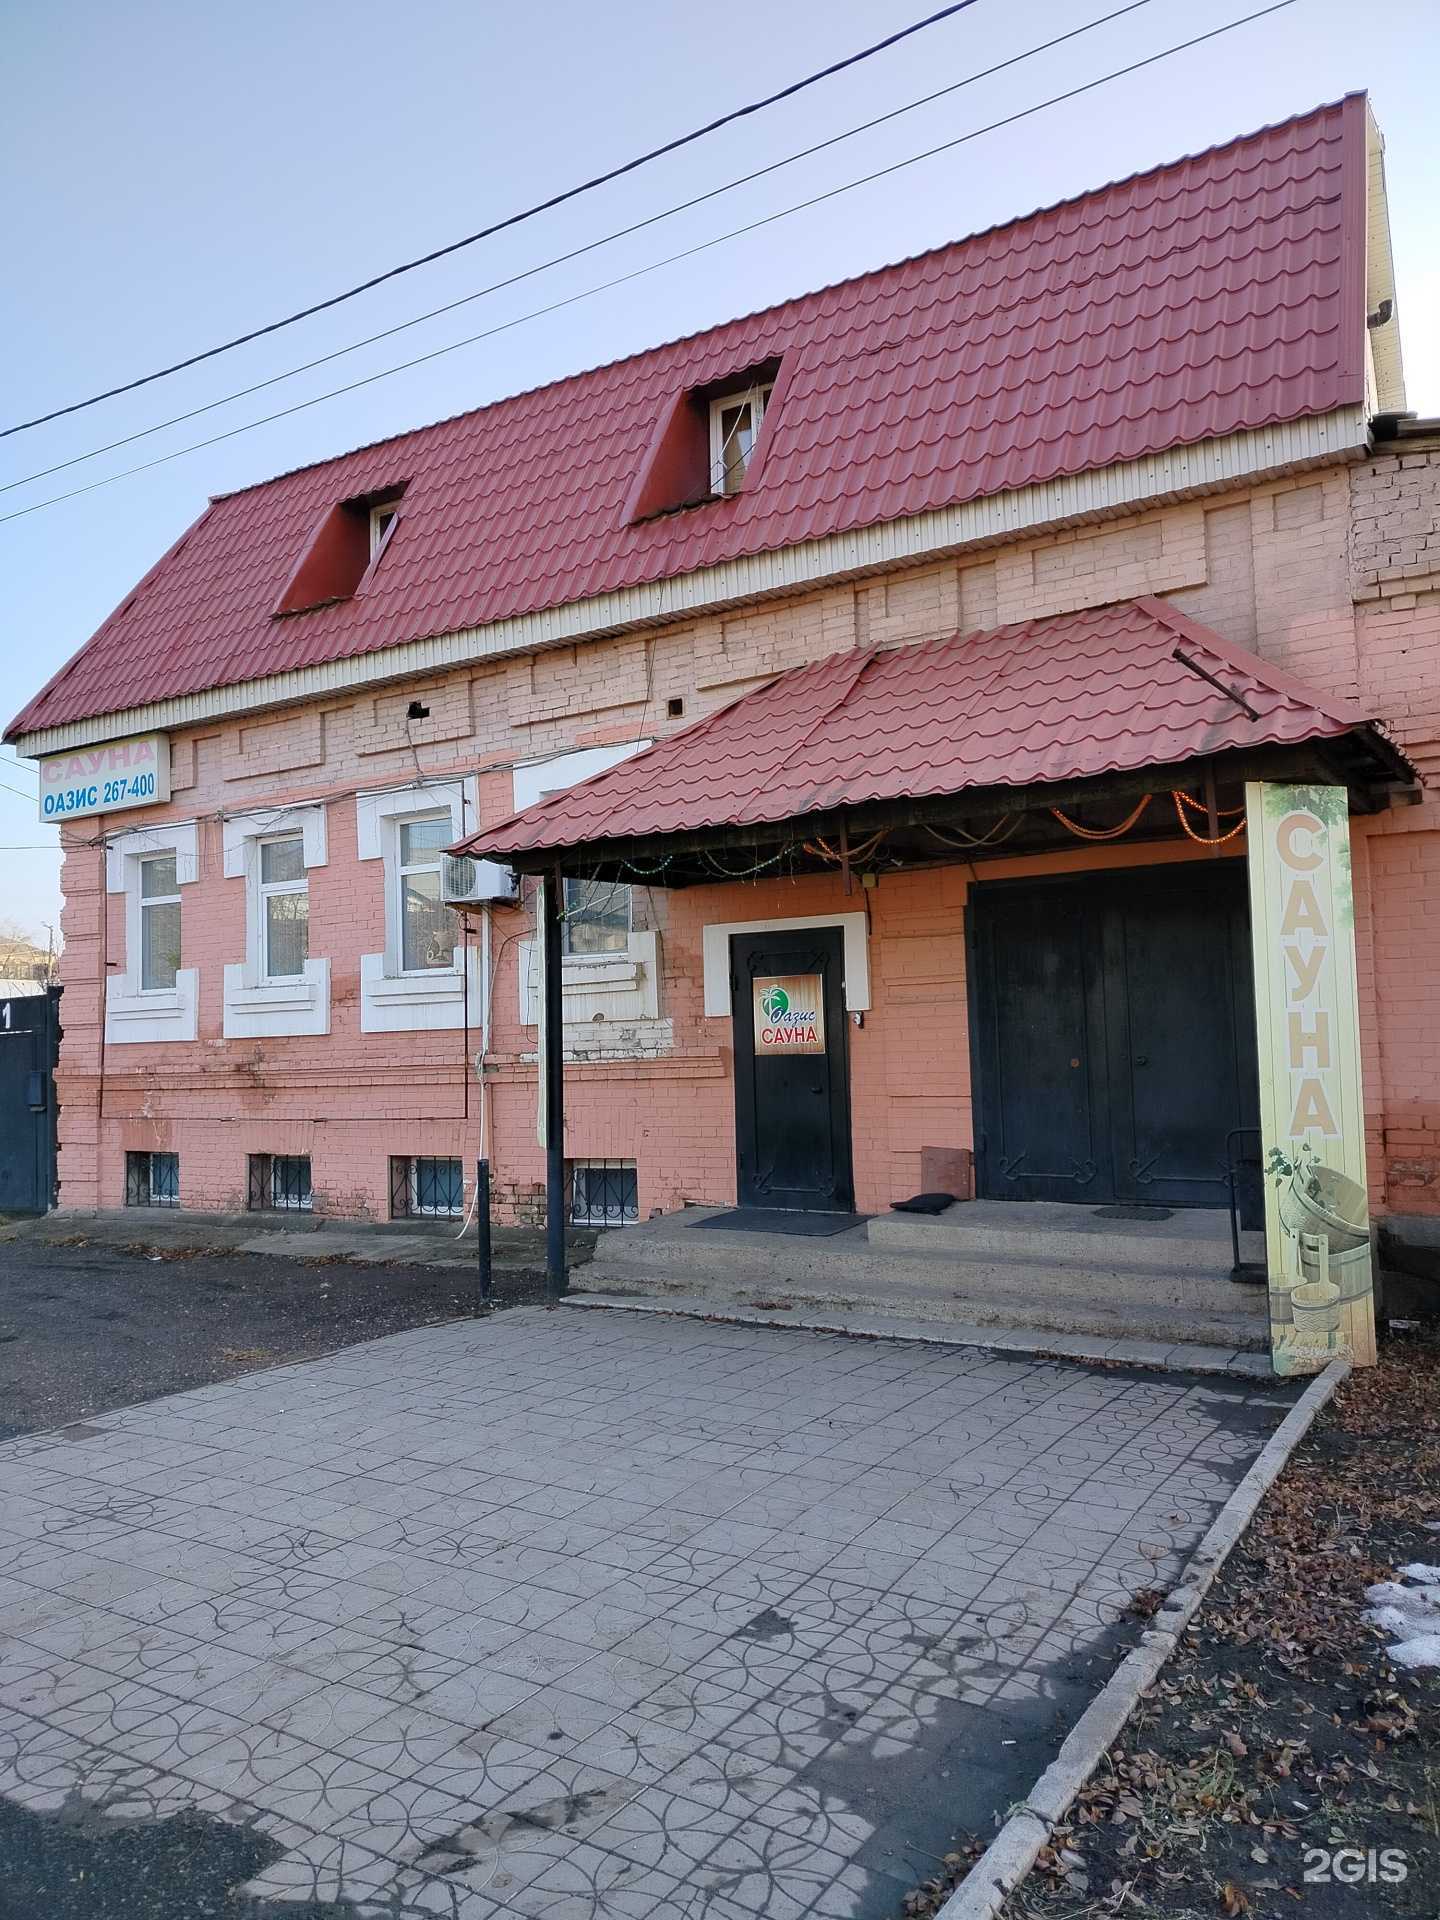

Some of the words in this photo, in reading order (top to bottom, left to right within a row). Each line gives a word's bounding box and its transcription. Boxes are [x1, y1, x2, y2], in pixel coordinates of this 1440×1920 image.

[42, 740, 154, 784] САУНА
[44, 786, 98, 814] ОАЗИС
[103, 772, 155, 804] 267-400
[1275, 813, 1338, 1136] САУНА
[762, 1026, 817, 1044] САУНА
[770, 1006, 816, 1026] Оазис
